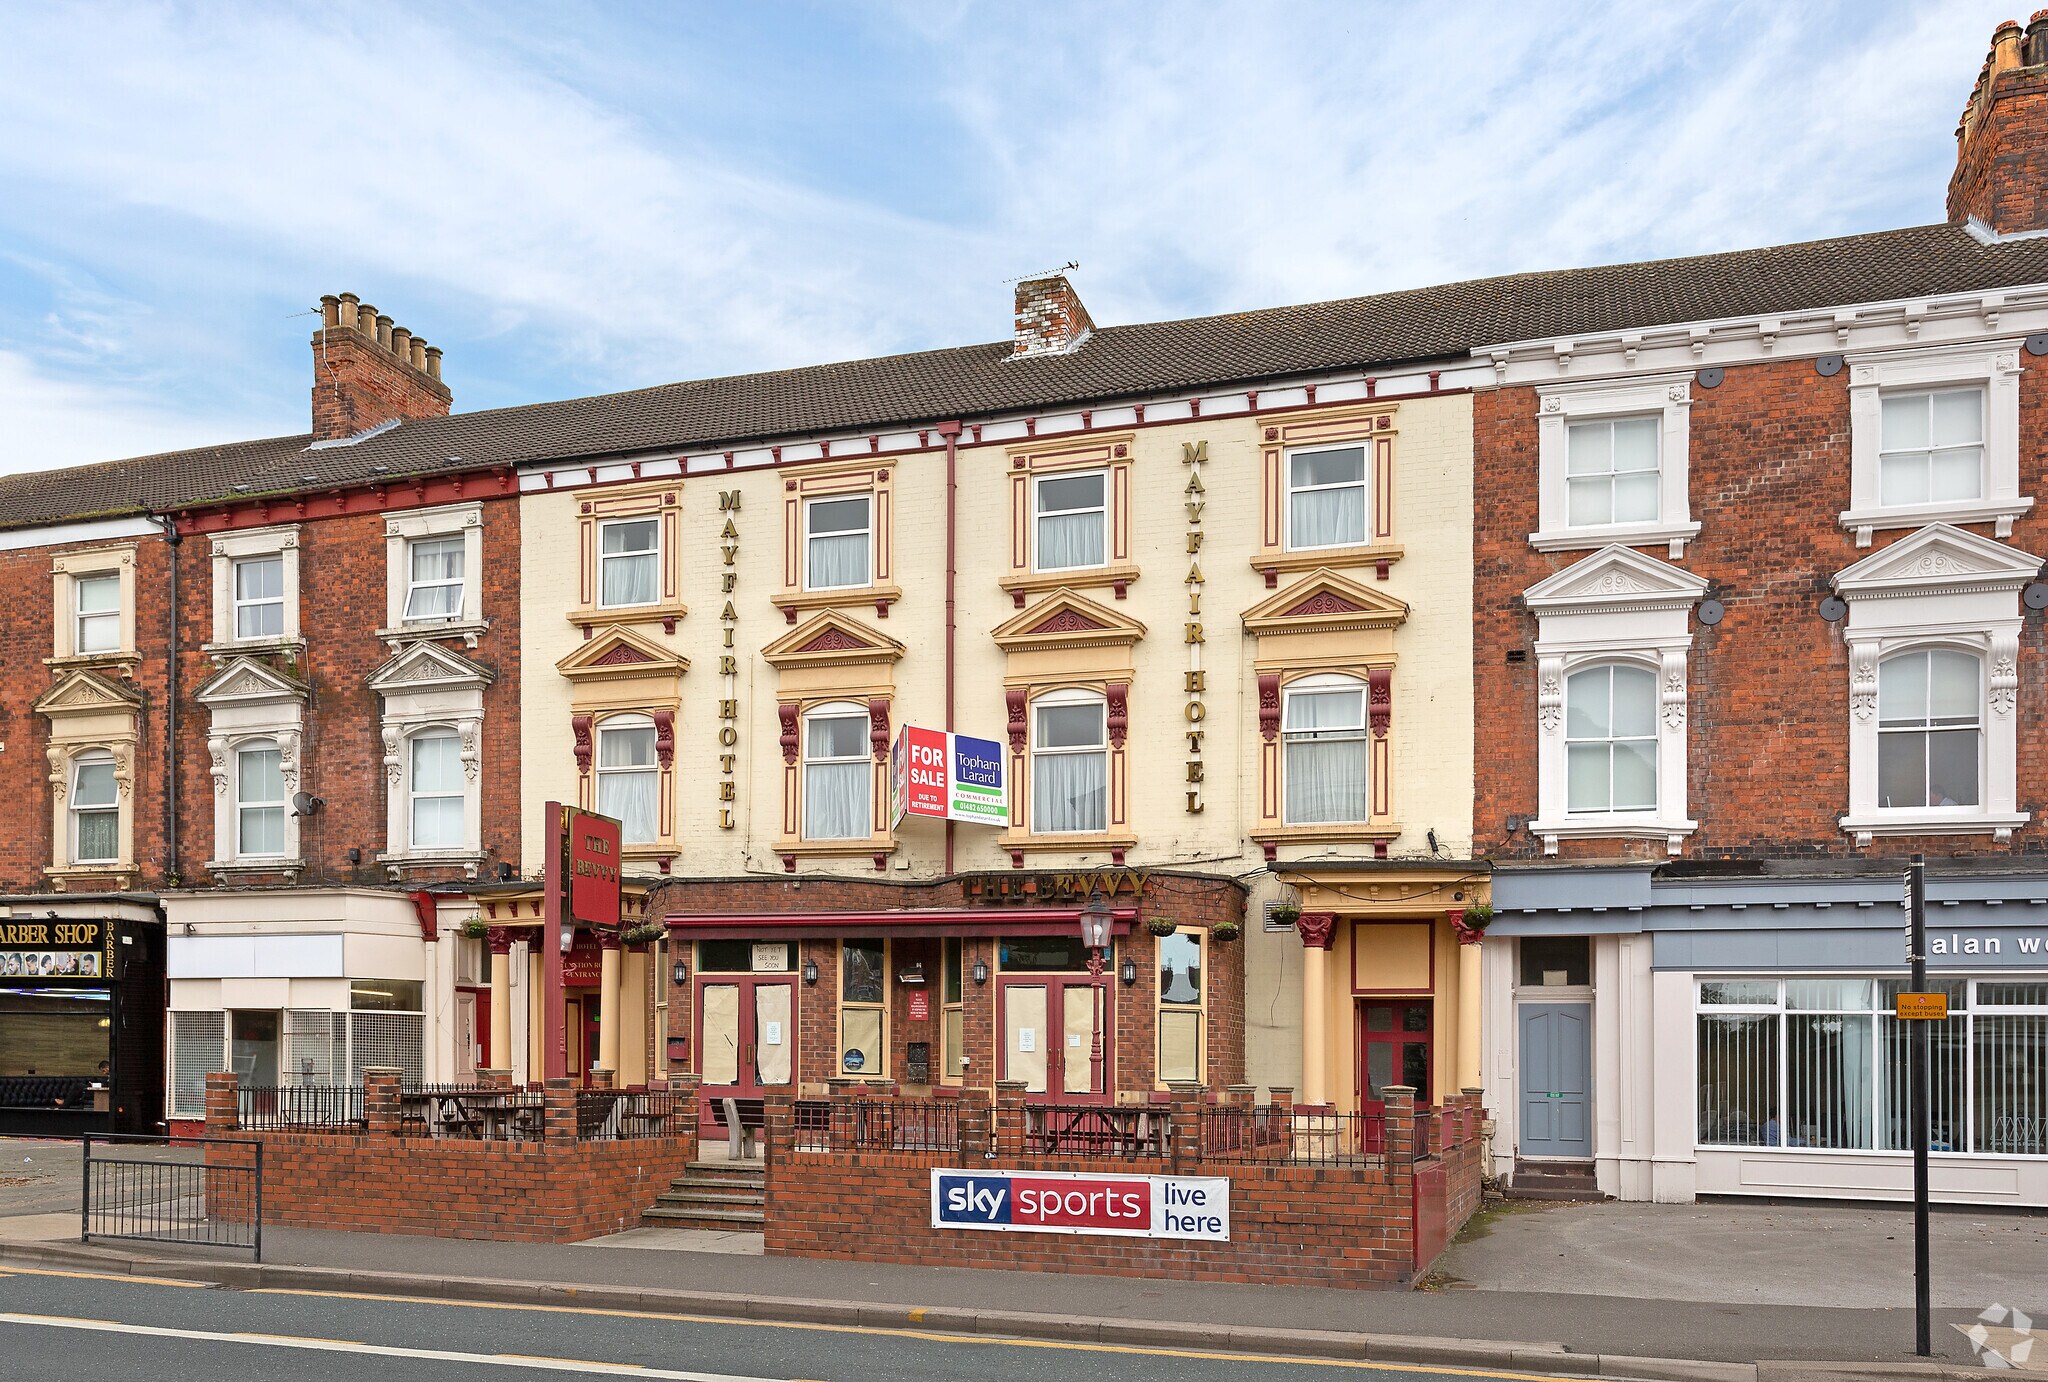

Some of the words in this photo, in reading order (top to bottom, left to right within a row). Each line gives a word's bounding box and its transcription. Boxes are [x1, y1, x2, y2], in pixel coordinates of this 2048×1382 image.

[1181, 439, 1208, 645] MAYFAIR
[718, 489, 741, 675] MAYFAIR
[1184, 670, 1206, 814] HOTEL
[718, 698, 738, 831] HOTEL
[911, 744, 944, 768] FOR
[957, 752, 1000, 772] Topham
[910, 768, 945, 788] SALE
[962, 768, 996, 784] Larard
[911, 800, 945, 811] RETIREMENT
[918, 793, 930, 801] DUE
[955, 792, 1004, 804] COMMERCIAL
[959, 801, 976, 812] 01482
[976, 803, 999, 815] 650000
[584, 833, 610, 855] THE
[576, 858, 617, 883] BEVVY
[957, 874, 1027, 900] THE
[1033, 871, 1152, 899] BEVVY
[54, 924, 99, 944] SHOP
[1931, 933, 2001, 955] alan
[2017, 937, 2048, 954] w
[105, 921, 116, 978] BARBER
[947, 1180, 1006, 1220] sky
[1018, 1187, 1142, 1222] sports
[1163, 1182, 1207, 1206] live
[1163, 1209, 1222, 1233] here
